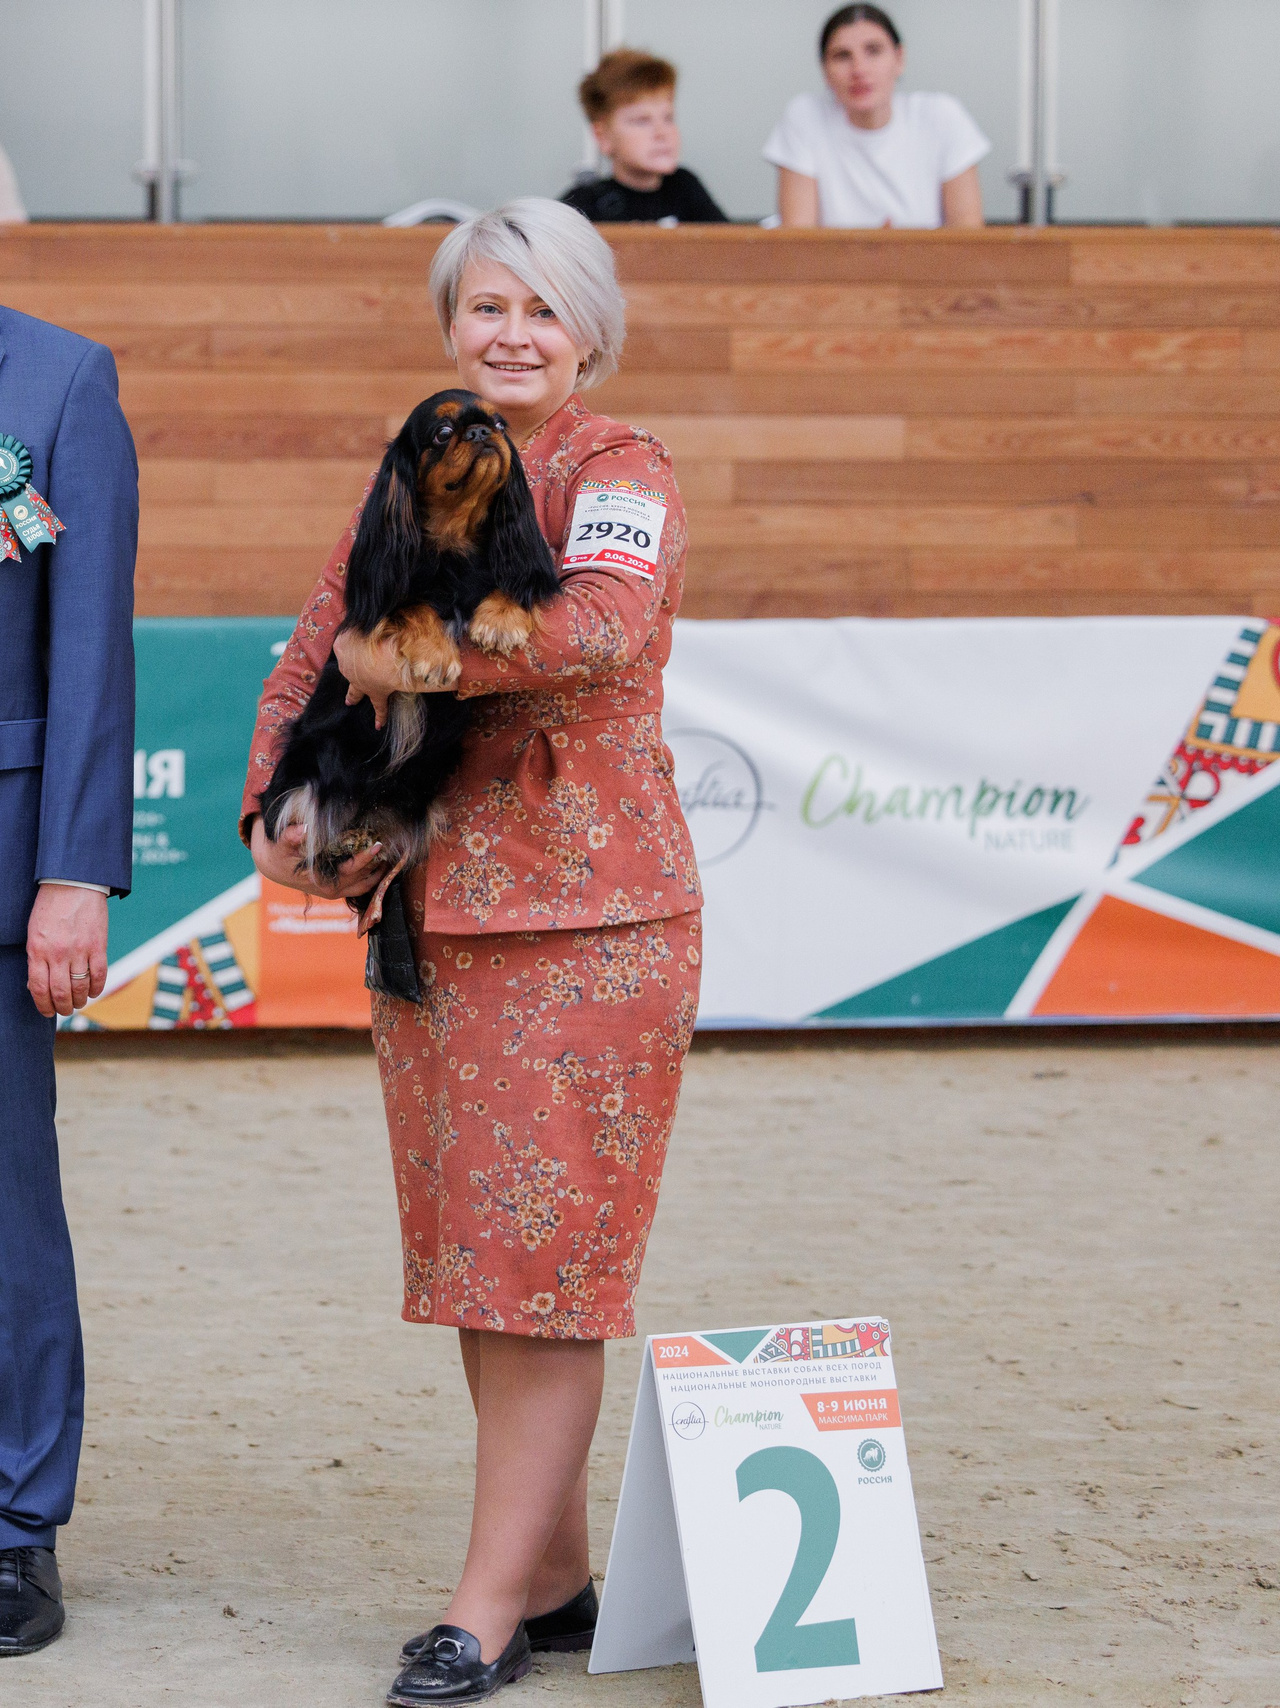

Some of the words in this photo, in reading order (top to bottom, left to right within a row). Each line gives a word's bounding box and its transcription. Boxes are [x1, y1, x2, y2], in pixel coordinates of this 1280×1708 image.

[611, 495, 646, 508] РОССИЯ
[15, 515, 37, 529] РОССИЯ
[22, 523, 41, 537] СУДЬЯ
[26, 530, 44, 544] JUDGE
[576, 521, 651, 549] 2920
[604, 552, 650, 571] 9.06.2024
[801, 753, 1090, 838] Champion
[983, 827, 1075, 854] NATURE
[658, 1345, 689, 1359] 2024
[662, 1370, 740, 1381] НАЦИОНАЛЬНЫЕ
[742, 1367, 791, 1377] ВЫСТАВКИ
[793, 1365, 823, 1374] СОБАК
[826, 1363, 848, 1372] ВСЕХ
[851, 1361, 882, 1371] ПОРОД
[670, 1382, 747, 1393] НАЦИОНАЛЬНЫЕ
[750, 1377, 827, 1388] МОНОПОРОДНЫЕ
[829, 1374, 877, 1384] ВЫСТАВКИ
[817, 1401, 839, 1413] 8-9
[843, 1398, 888, 1412] ИЮНЯ
[714, 1405, 784, 1429] Champion
[818, 1414, 864, 1425] МАКСИМА
[865, 1413, 888, 1423] ПАРК
[858, 1475, 892, 1485] РОССИЯ
[735, 1445, 861, 1673] 2
